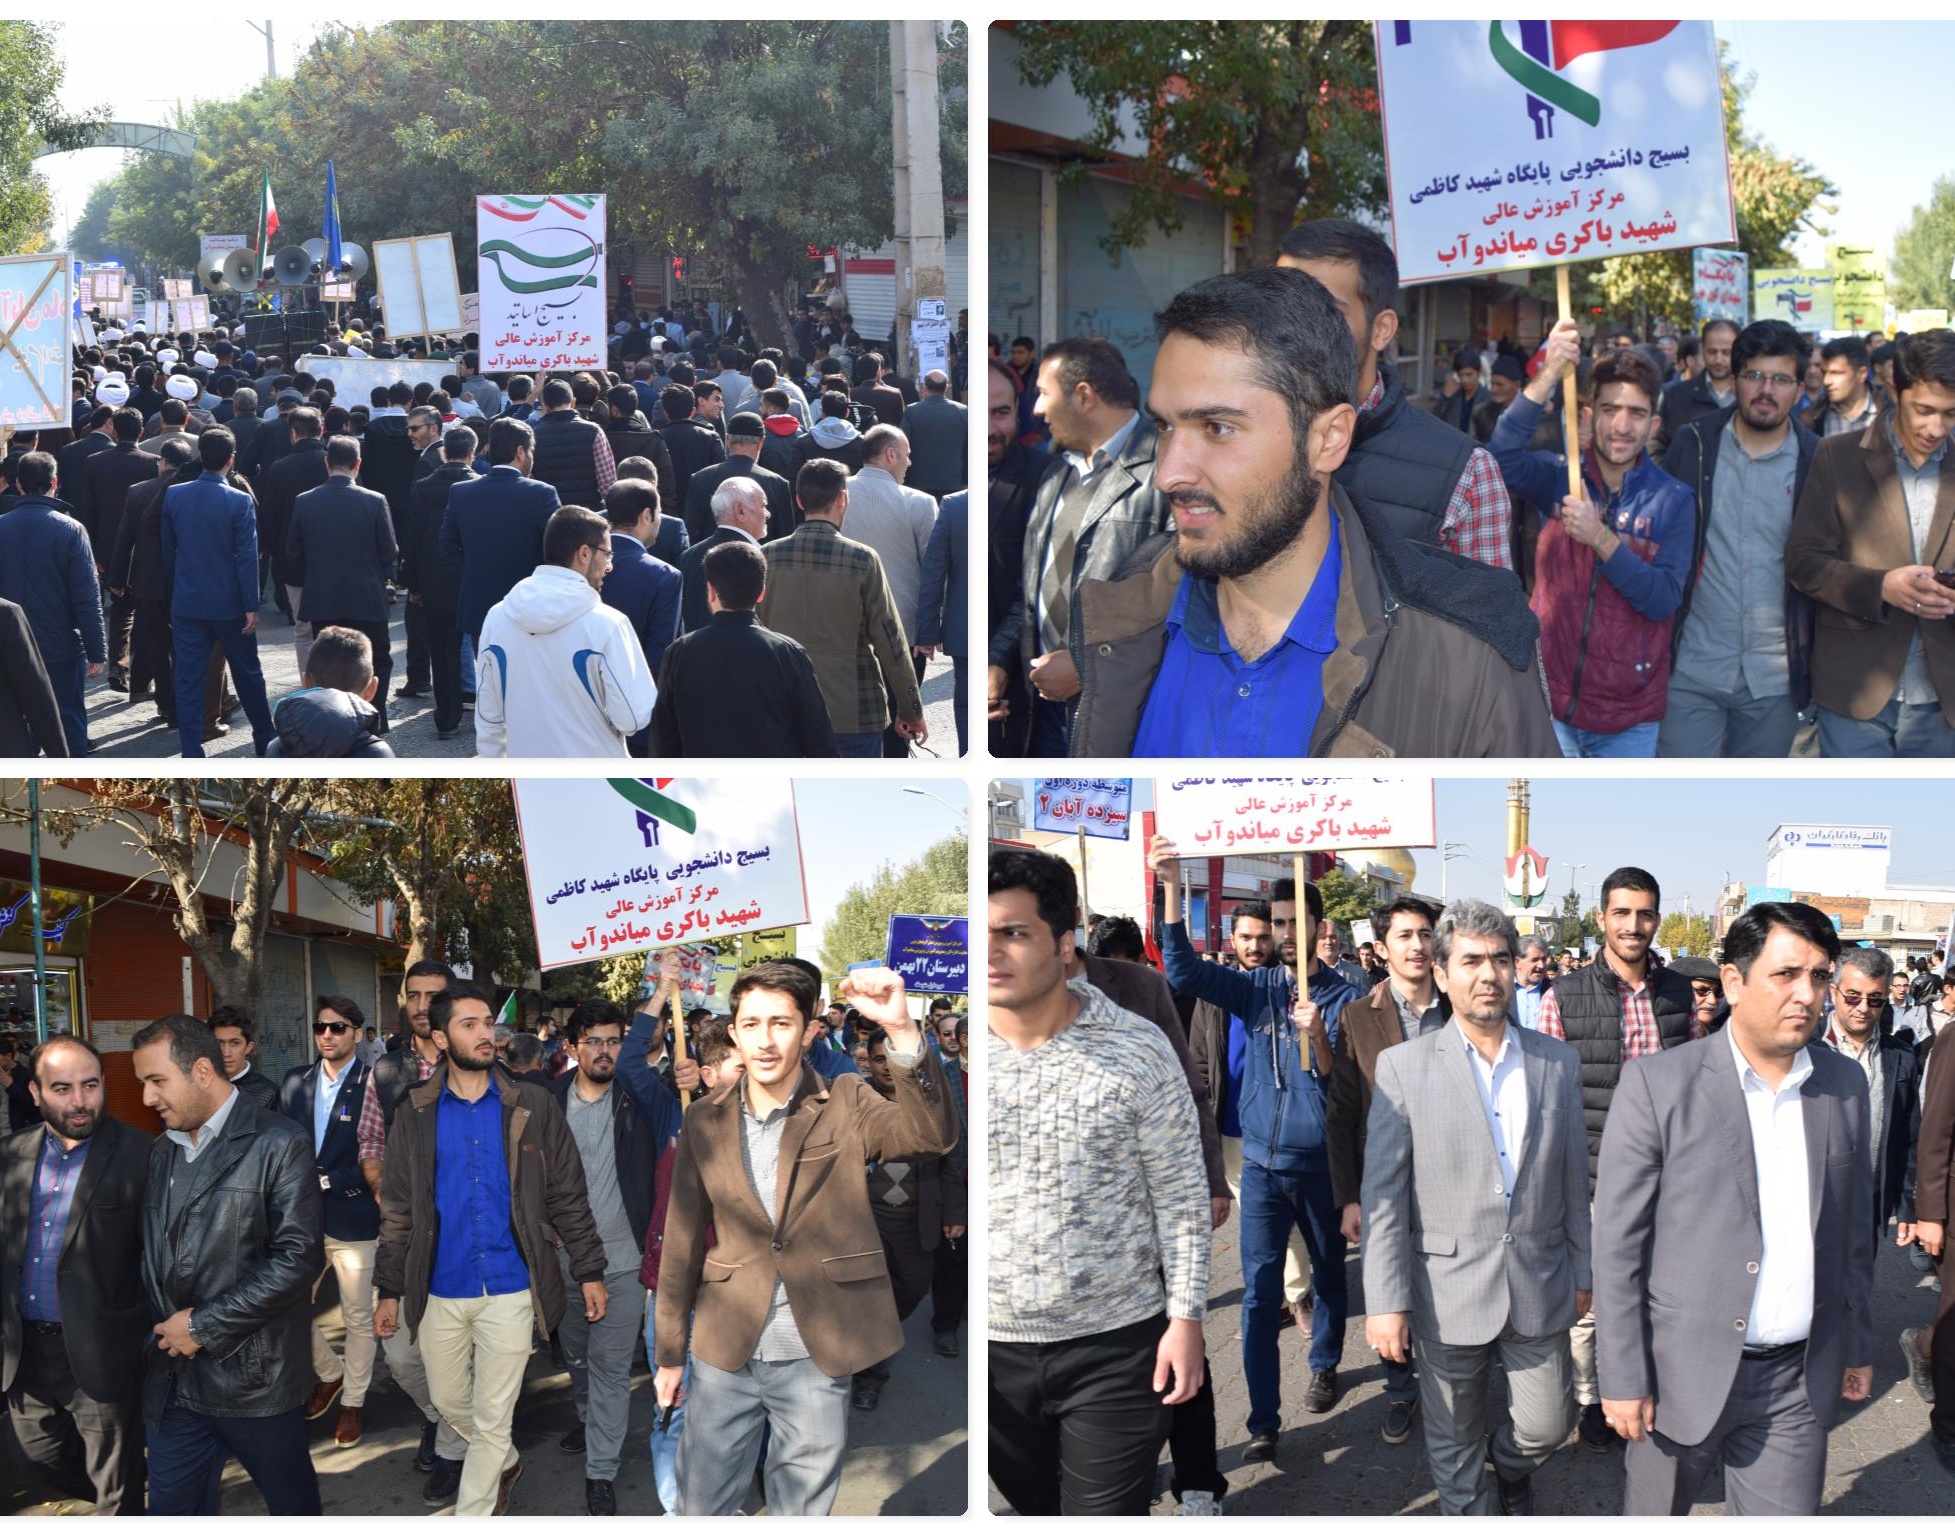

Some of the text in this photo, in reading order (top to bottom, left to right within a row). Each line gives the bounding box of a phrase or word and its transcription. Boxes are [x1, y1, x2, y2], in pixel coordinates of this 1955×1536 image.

[1409, 145, 1690, 204] بسیج دانشجویی پایگاه شهید کاظمی
[1483, 188, 1625, 225] مرکز آموزش عالی
[1545, 218, 1613, 256] باکری
[1620, 211, 1677, 244] شهید
[495, 330, 591, 347] مرکز آموزش عالی
[540, 354, 571, 368] باکری
[574, 353, 599, 367] شهید
[1052, 797, 1083, 819] آبان
[1087, 805, 1127, 824] سیزده
[1235, 794, 1352, 815] مرکز آموزش عالی
[1286, 818, 1341, 844] باکری
[1348, 816, 1392, 841] شهید
[546, 845, 770, 904] بسیج دانشجویی پایگاه شهید کاظمی
[605, 884, 719, 919] مرکز آموزش عالی
[716, 900, 762, 928] شهید
[656, 908, 711, 941] باکری
[752, 930, 786, 943] بسیج
[894, 961, 915, 975] بهمن
[926, 959, 966, 978] دبیرستان
